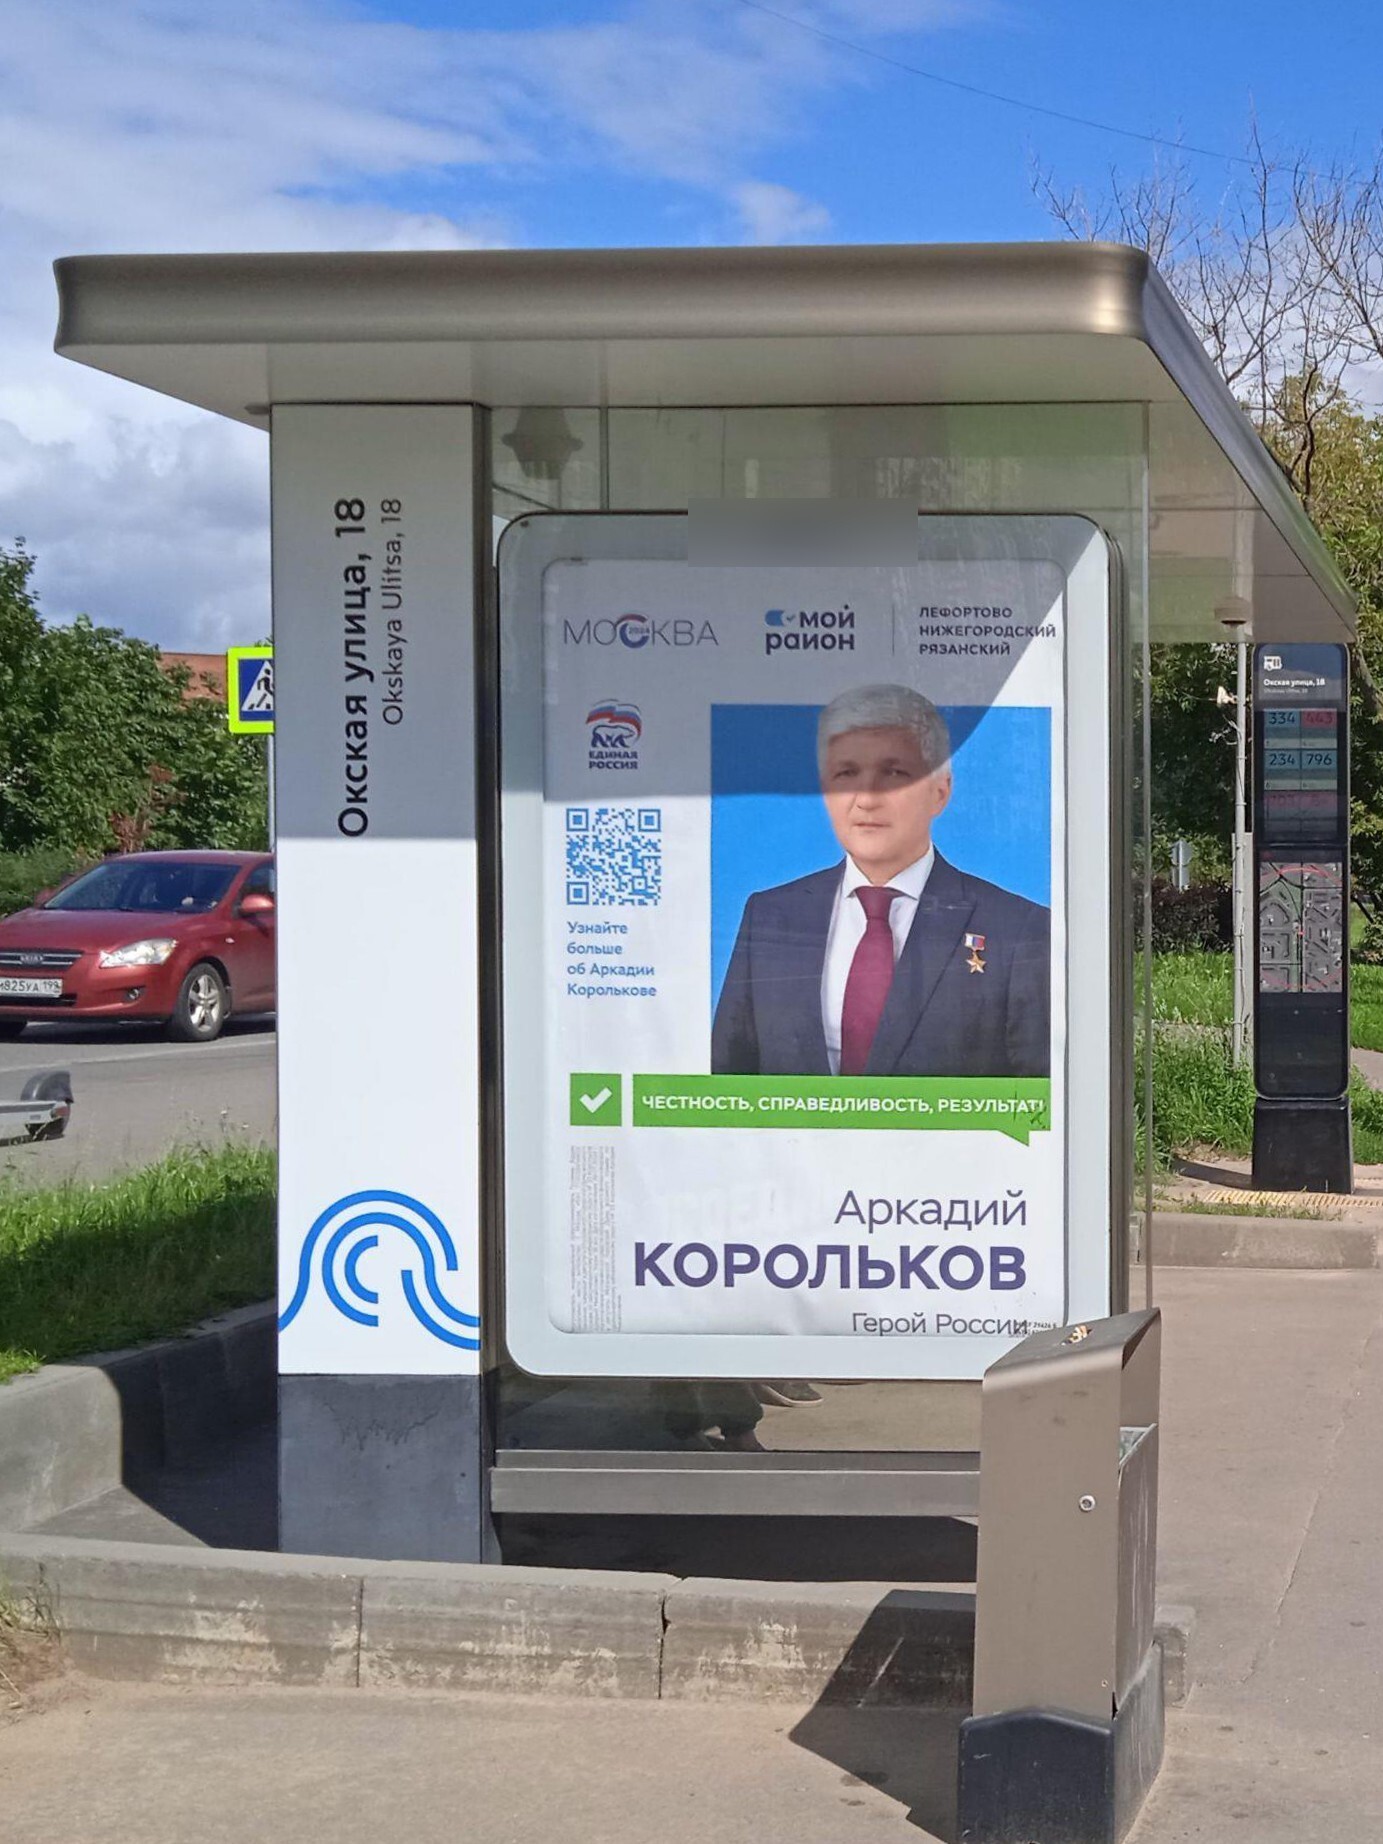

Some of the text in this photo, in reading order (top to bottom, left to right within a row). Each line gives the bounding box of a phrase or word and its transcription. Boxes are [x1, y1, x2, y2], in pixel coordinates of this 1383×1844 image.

[380, 499, 408, 726] Okskaya Ulitsa, 18
[799, 604, 855, 628] мой
[919, 606, 1013, 619] ЛЕФОРТОВО
[919, 624, 1057, 639] НИЖЕГОРОДСКИЙ
[919, 642, 1011, 656] РЯЗАНСКИЙ
[334, 498, 374, 837] Окская улица, 18
[1268, 712, 1296, 724] 334
[588, 751, 638, 759] ЕДИНАЯ
[1269, 754, 1333, 766] 234 796
[588, 761, 638, 770] РОССИЯ
[567, 921, 628, 934] Узнайте
[567, 942, 622, 954] больше
[567, 962, 655, 978] об Аркадии
[567, 983, 657, 999] Королькове
[642, 1096, 754, 1112] ЧЕСТНОСТЬ,
[758, 1097, 933, 1114] СПРАВЕДЛИВОСТЬ,
[834, 1190, 1027, 1233] Аркадий
[634, 1242, 1027, 1290] КОРОЛЬКОВ
[852, 1312, 1028, 1336] Герой России
